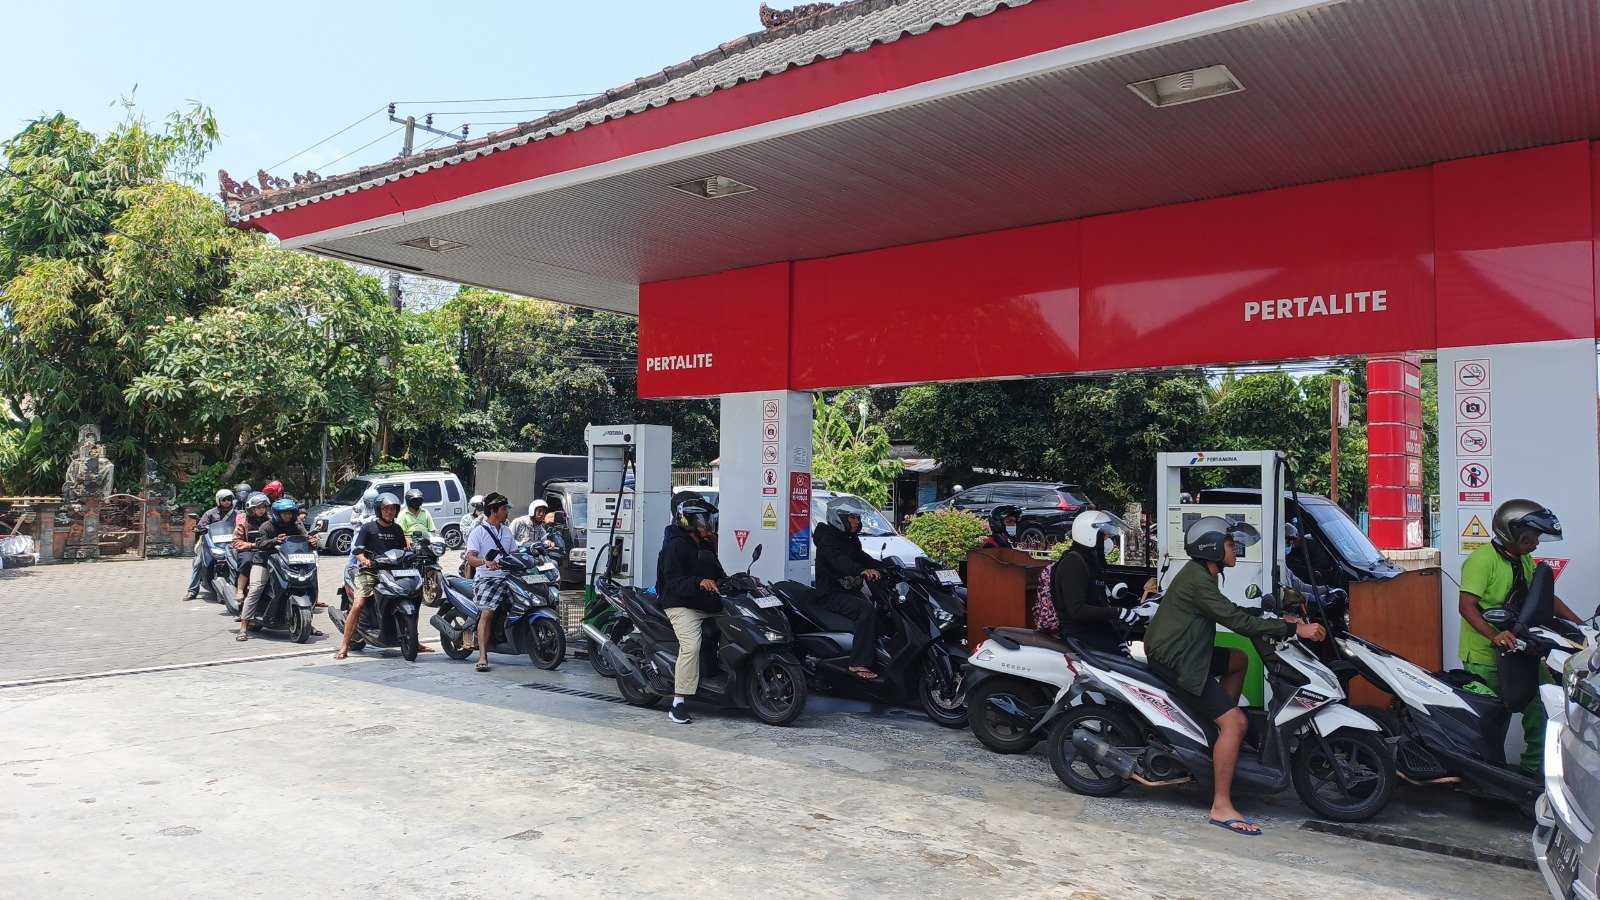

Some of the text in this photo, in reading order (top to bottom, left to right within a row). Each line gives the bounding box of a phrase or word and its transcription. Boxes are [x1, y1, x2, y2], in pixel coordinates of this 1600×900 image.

[1244, 290, 1387, 322] PERTALITE
[646, 353, 713, 371] PERTALITE
[1301, 690, 1324, 700] HONDA
